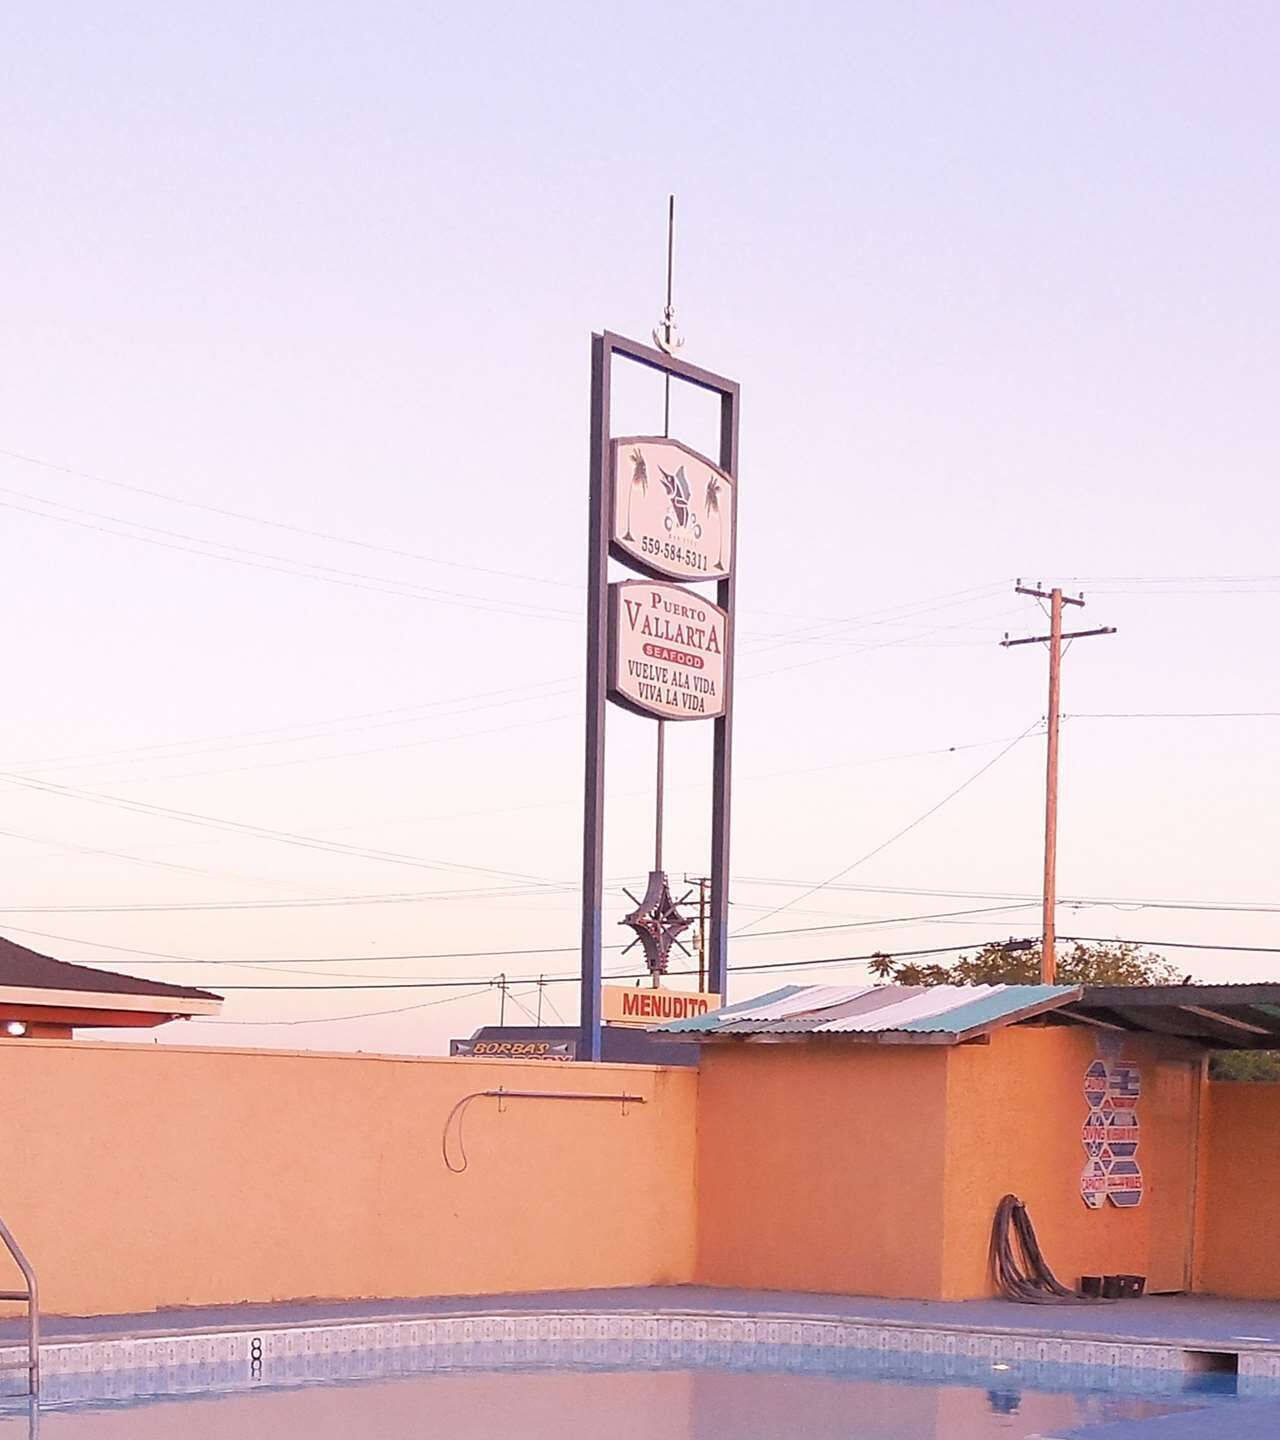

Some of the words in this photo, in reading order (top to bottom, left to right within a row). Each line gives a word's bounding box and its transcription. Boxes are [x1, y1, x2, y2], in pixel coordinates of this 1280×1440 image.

[641, 536, 709, 571] 559-584-5311
[624, 599, 721, 654] VALLARTA
[645, 645, 702, 668] SEAFOOD
[628, 660, 668, 684] VUELVE
[693, 676, 716, 697] VIDA
[638, 682, 663, 703] VIVA
[666, 688, 678, 707] LA
[682, 692, 705, 713] VIDA
[622, 993, 708, 1018] MENUDITO
[472, 1042, 550, 1054] BORBA'S
[251, 1337, 262, 1360] 8
